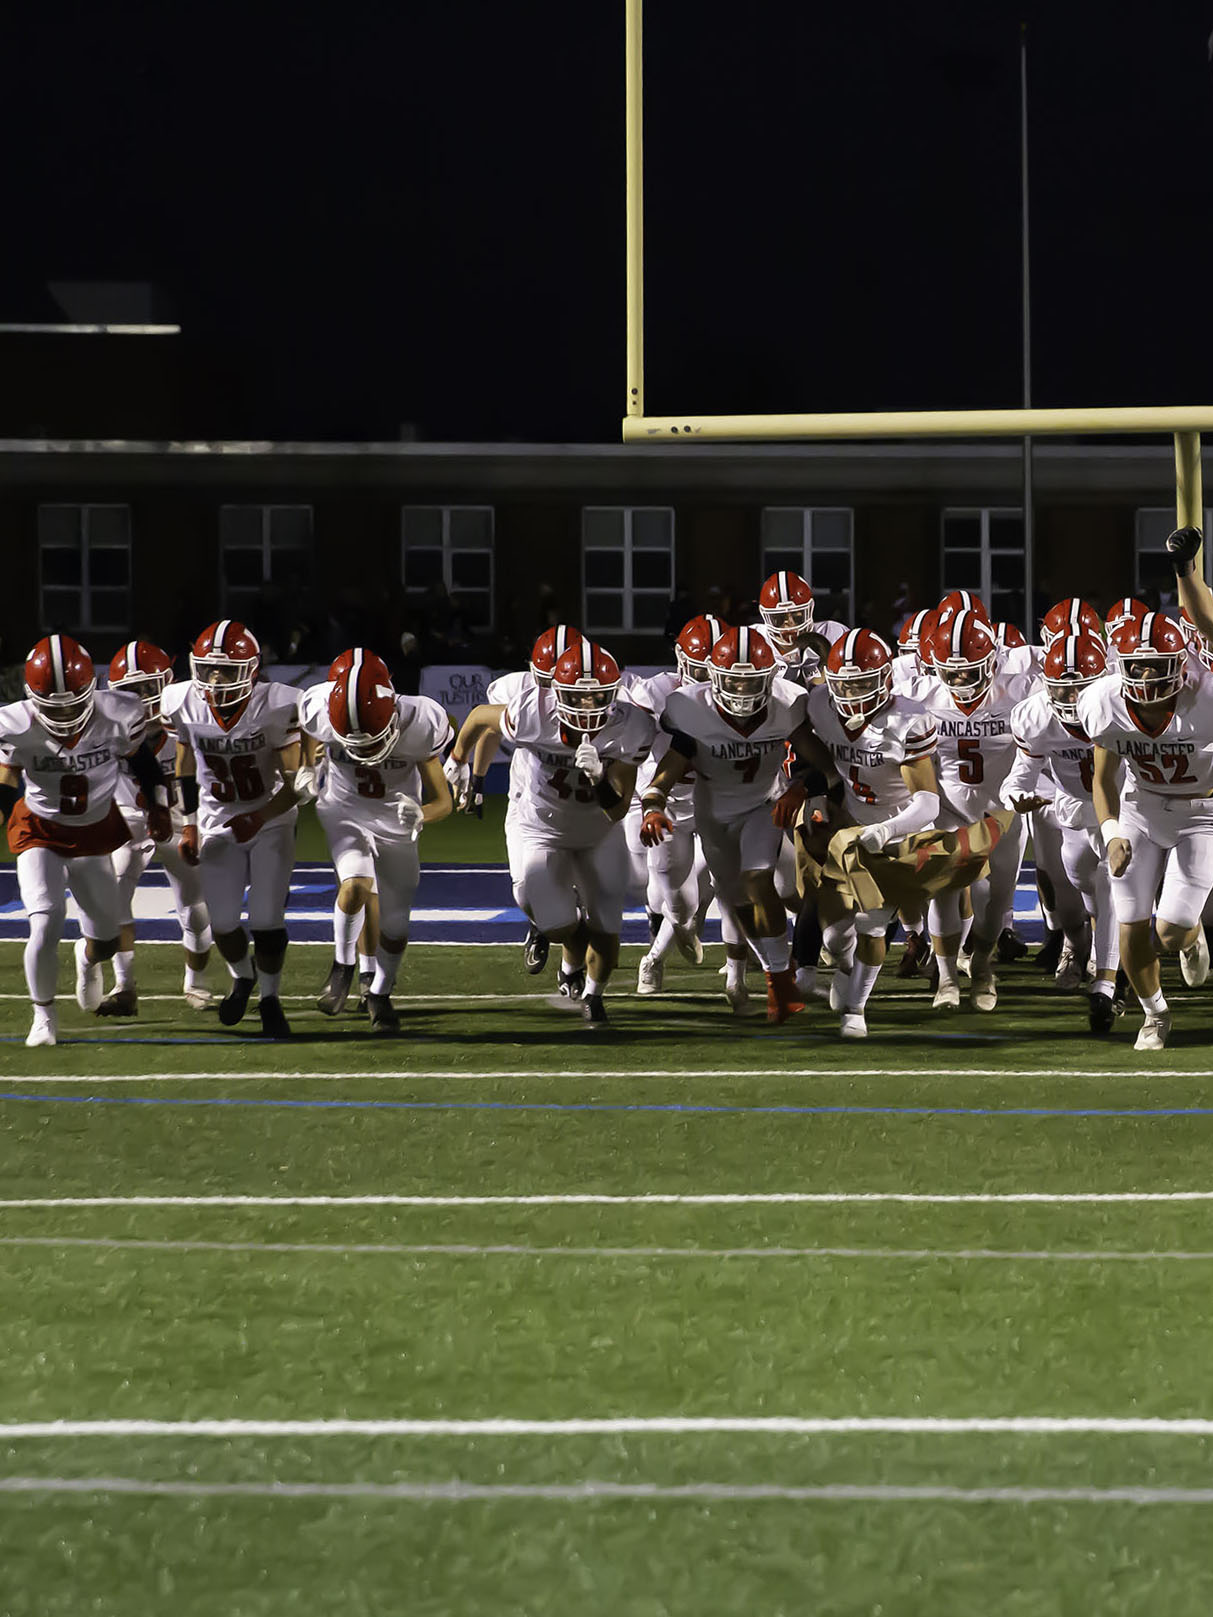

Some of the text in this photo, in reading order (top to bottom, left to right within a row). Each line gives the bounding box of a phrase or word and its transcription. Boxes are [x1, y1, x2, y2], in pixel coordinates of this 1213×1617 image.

[937, 720, 1006, 737] ANCASTER
[197, 733, 266, 755] ANCASTER
[1115, 740, 1195, 756] LANCASTER
[735, 757, 761, 784] 7
[957, 739, 985, 785] 5
[1134, 754, 1198, 785] 52
[202, 755, 265, 802] 36
